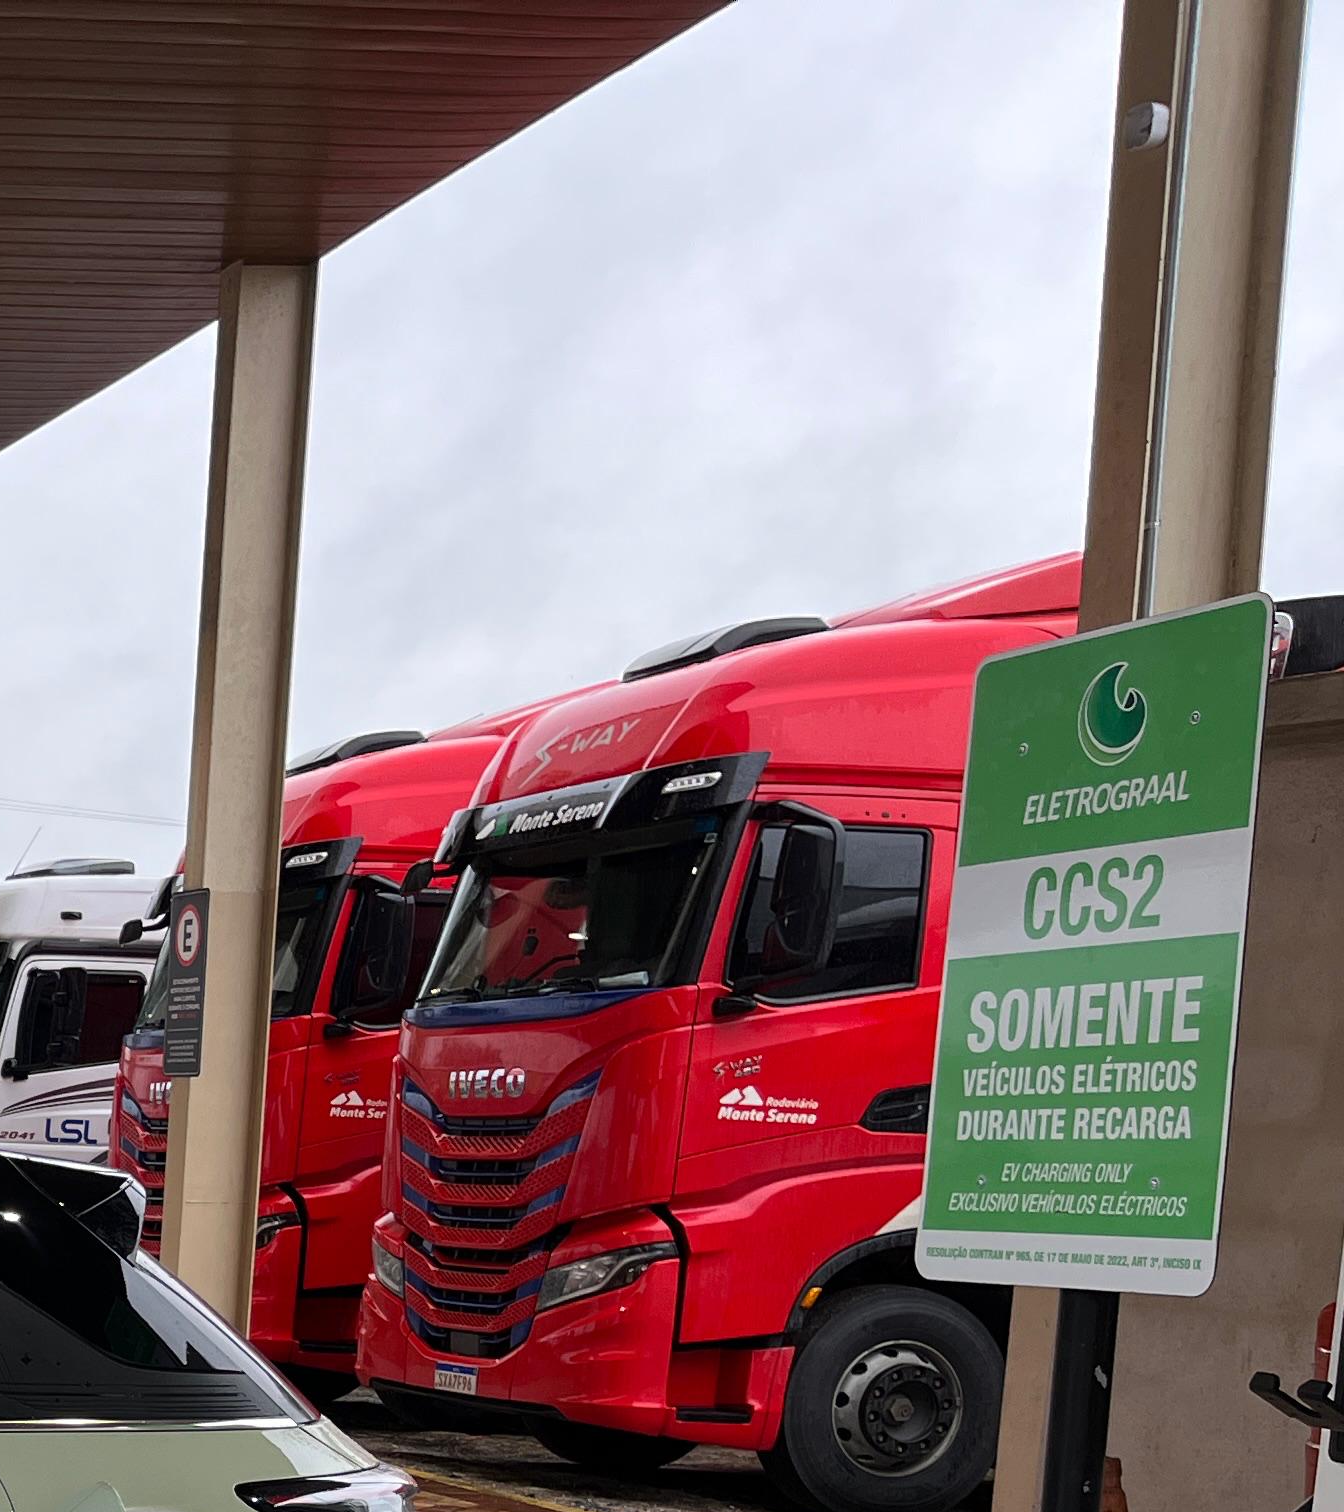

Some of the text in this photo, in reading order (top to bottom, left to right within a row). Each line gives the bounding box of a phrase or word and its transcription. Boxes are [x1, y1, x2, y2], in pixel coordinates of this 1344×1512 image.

[1022, 770, 1191, 826] ELETROGRAAL
[509, 801, 605, 835] Monte Sereno
[1023, 854, 1165, 941] CCS2
[967, 975, 1204, 1054] SOMENTE
[448, 1067, 526, 1099] IVECO
[963, 1056, 1198, 1097] VEÍCULOS ELÉTRICOS
[329, 1106, 387, 1119] Monte Ser
[717, 1106, 817, 1125] Monte Sereno
[765, 1096, 819, 1110] Rodoviário
[45, 1118, 98, 1145] LSL
[956, 1105, 1193, 1141] DURANTE RECARGA
[1001, 1162, 1134, 1184] EV CHARGING ONLY
[948, 1190, 1188, 1217] EXCLUSIVO VEHÍCULOS ELÉCTRICOS
[926, 1246, 967, 1260] RESOLUÇÃO
[969, 1248, 1004, 1261] CONTRAN
[1033, 1251, 1045, 1263] DE
[1047, 1252, 1056, 1263] 17
[1058, 1252, 1069, 1264] DE
[1070, 1253, 1092, 1265] MAIO
[1094, 1254, 1105, 1266] DE
